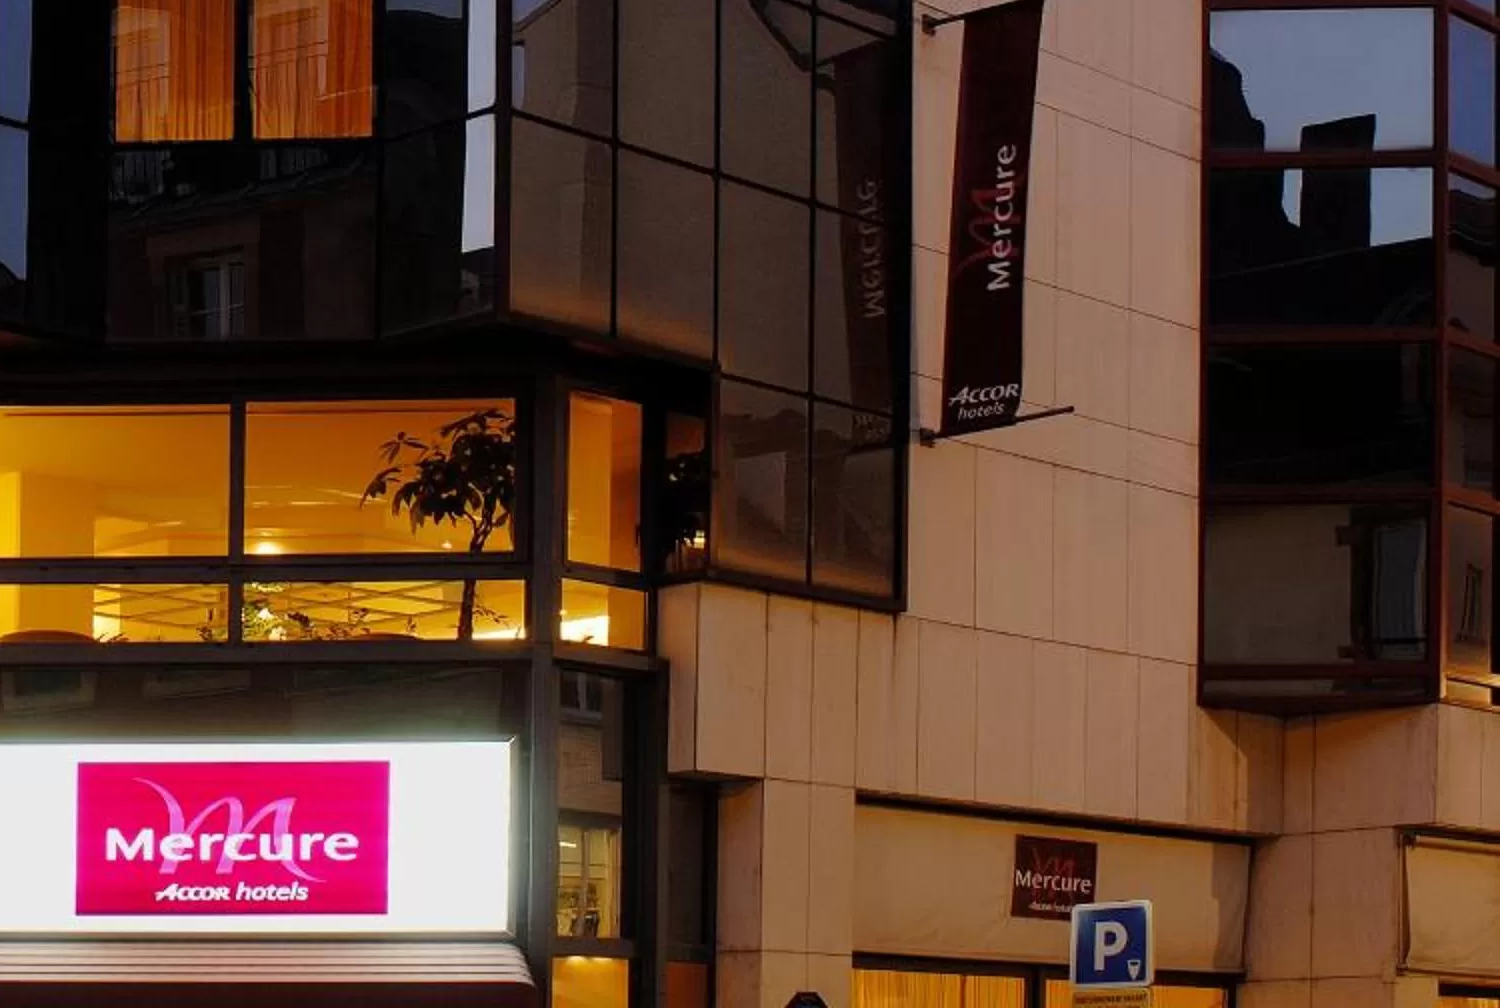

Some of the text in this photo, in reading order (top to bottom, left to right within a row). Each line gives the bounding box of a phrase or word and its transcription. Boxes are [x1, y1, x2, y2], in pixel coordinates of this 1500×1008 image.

[987, 144, 1016, 290] Mercure
[948, 384, 1019, 407] ACCOR
[958, 401, 1005, 420] hotels
[105, 827, 359, 861] Mercure
[155, 881, 309, 901] ACCOR hotels
[1015, 869, 1092, 894] Mercure
[1093, 921, 1129, 972] P
